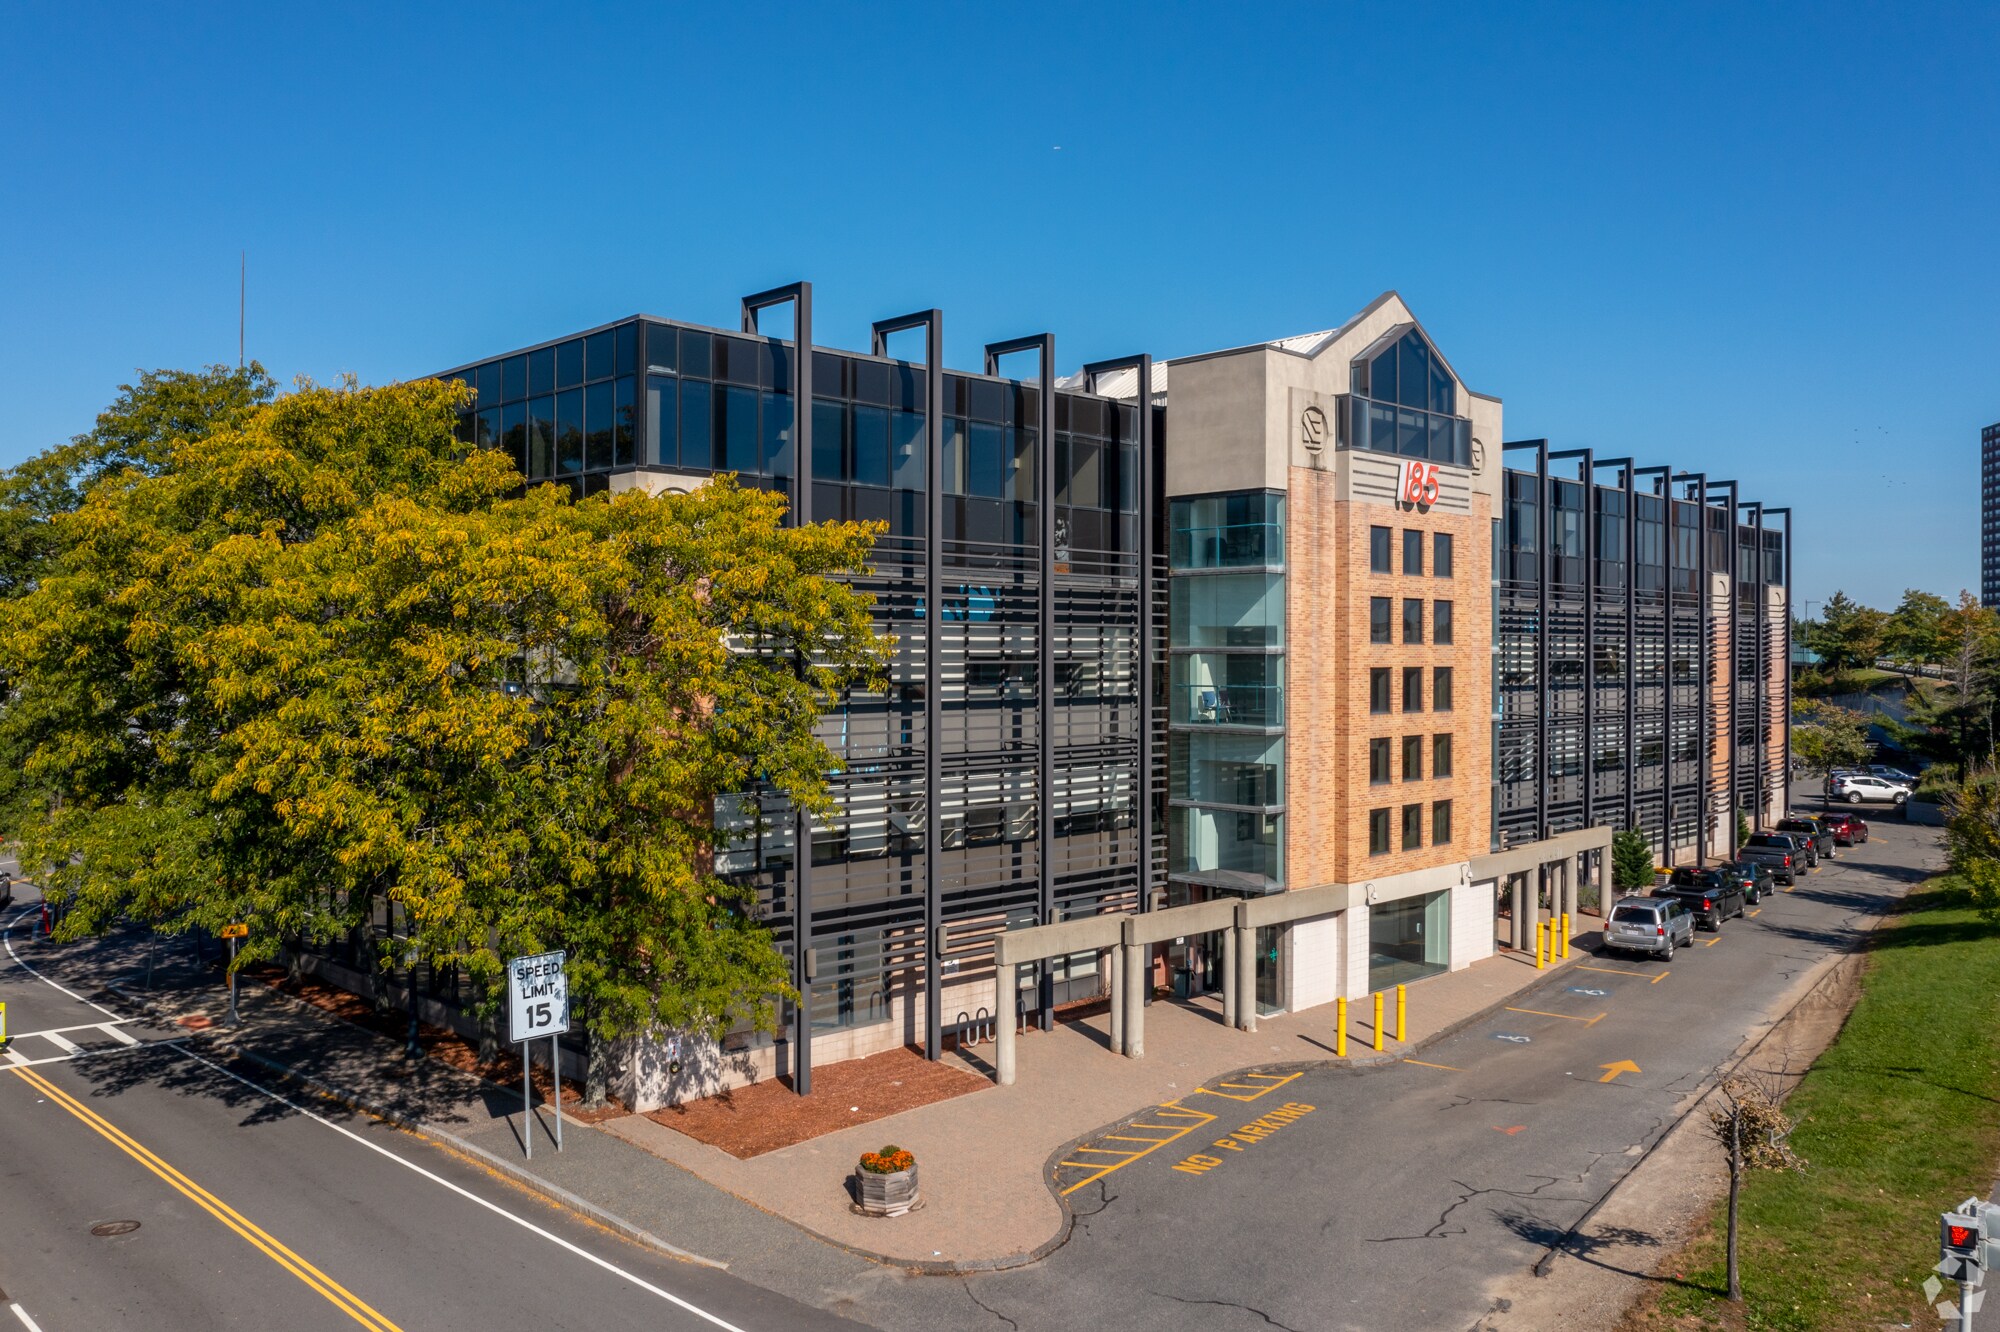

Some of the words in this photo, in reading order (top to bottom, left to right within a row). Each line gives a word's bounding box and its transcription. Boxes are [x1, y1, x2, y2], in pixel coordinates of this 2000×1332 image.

[1401, 461, 1440, 506] 185
[516, 962, 560, 981] SPEED
[522, 982, 555, 1000] LIMIT
[526, 1002, 552, 1029] 15
[1171, 1153, 1223, 1175] NO
[1212, 1102, 1317, 1151] PARKING
